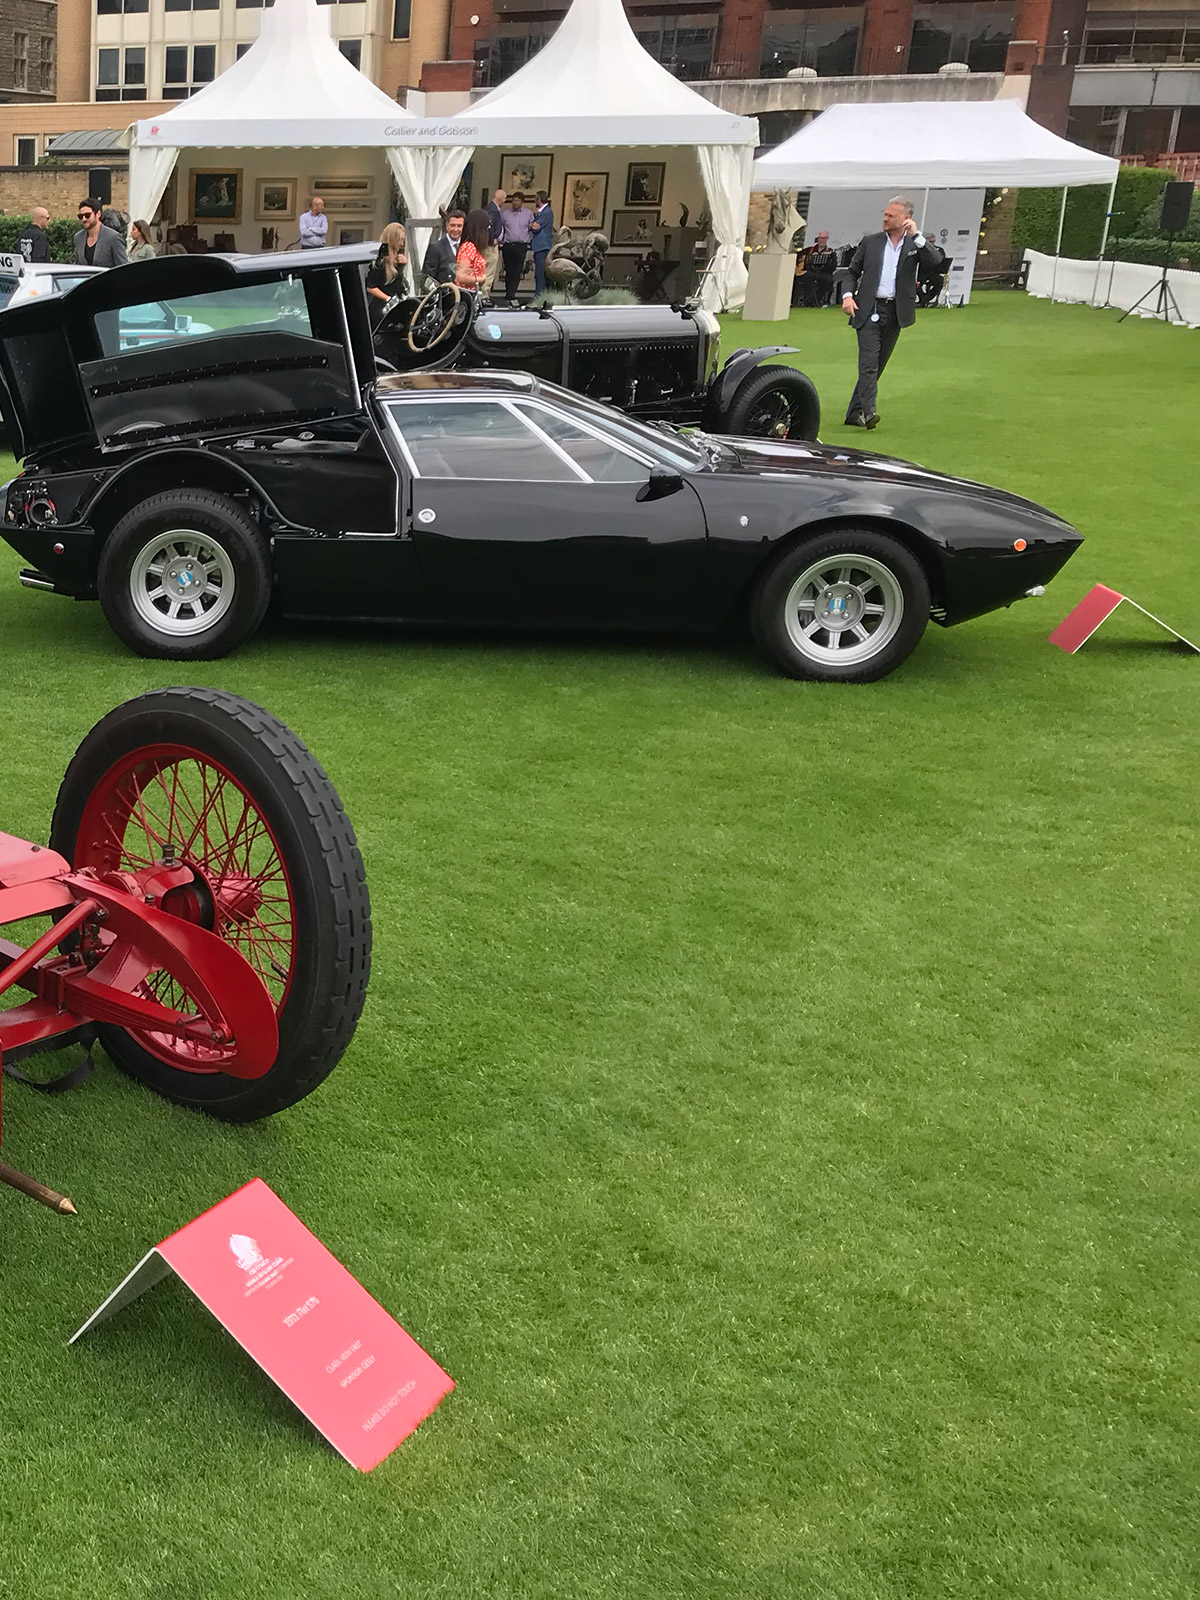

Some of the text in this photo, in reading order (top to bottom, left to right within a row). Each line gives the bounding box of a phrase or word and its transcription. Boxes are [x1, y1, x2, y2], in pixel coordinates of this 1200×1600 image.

[384, 125, 479, 136] Collier and Dobson
[339, 1348, 353, 1362] VERY
[349, 1339, 363, 1353] FAST
[361, 1379, 418, 1433] PLEASE DO NOT TOUCH
